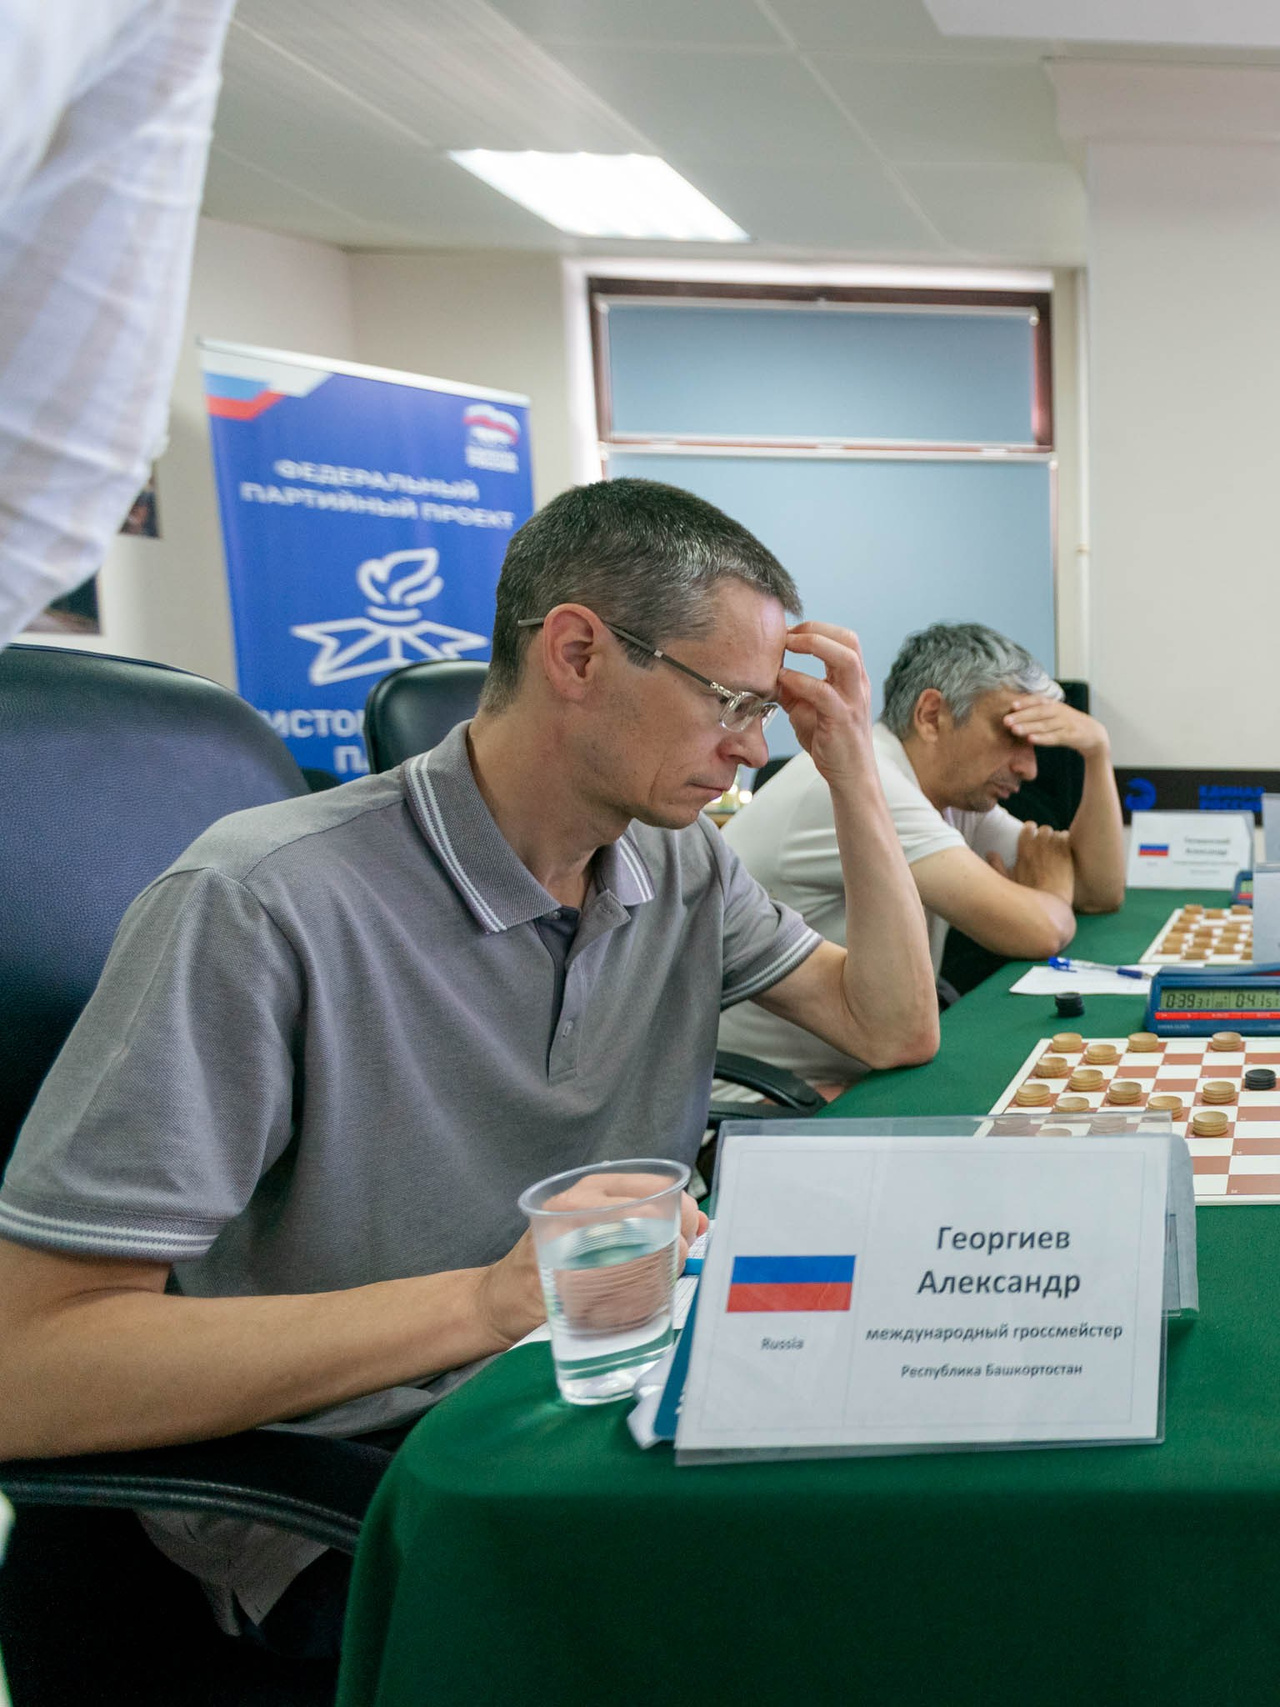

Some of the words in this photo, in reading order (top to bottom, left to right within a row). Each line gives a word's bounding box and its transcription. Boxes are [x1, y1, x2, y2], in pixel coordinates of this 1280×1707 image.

[273, 458, 479, 501] ФЕДЕРАЛЬНЫЙ
[239, 480, 418, 520] ПАРТИЙНЫЙ
[420, 501, 515, 530] ПРОЕКТ
[936, 1225, 1071, 1256] Георгиев
[915, 1269, 1082, 1300] Александр
[760, 1336, 805, 1351] Russia
[865, 1322, 1009, 1344] международный
[1012, 1321, 1124, 1342] гроссмейстер
[900, 1363, 983, 1380] Республика
[985, 1362, 1083, 1379] Башкортостан
